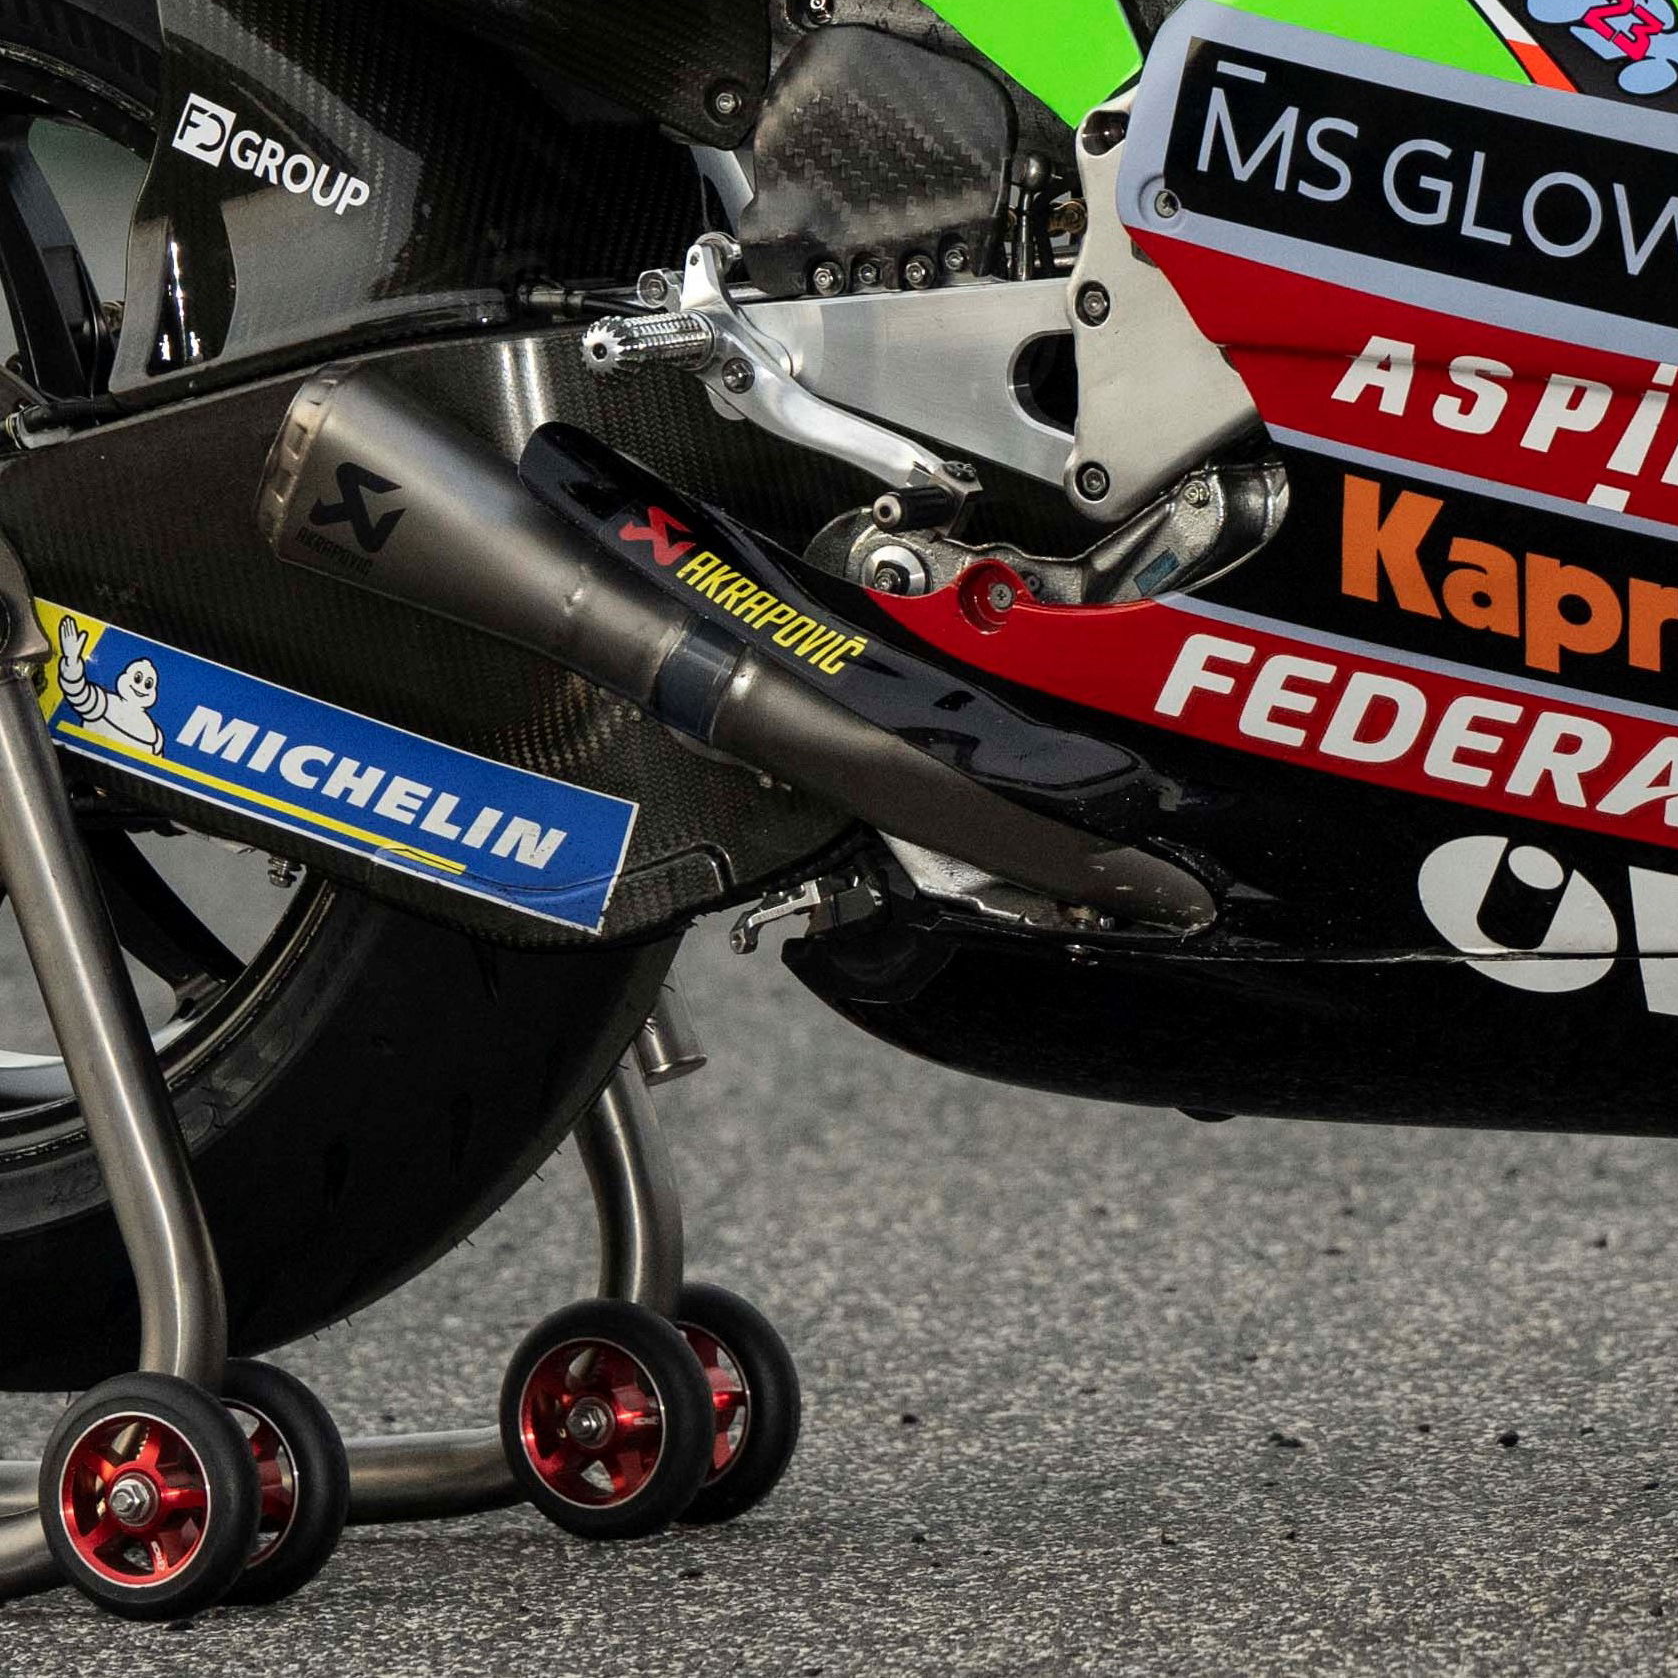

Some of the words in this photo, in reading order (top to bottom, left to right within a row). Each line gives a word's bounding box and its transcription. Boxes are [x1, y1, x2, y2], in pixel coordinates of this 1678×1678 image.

[230, 129, 370, 216] GROUP
[1197, 82, 1359, 203] MS
[675, 550, 870, 675] AKRAPOVIČ
[176, 704, 568, 870] MICHELIN
